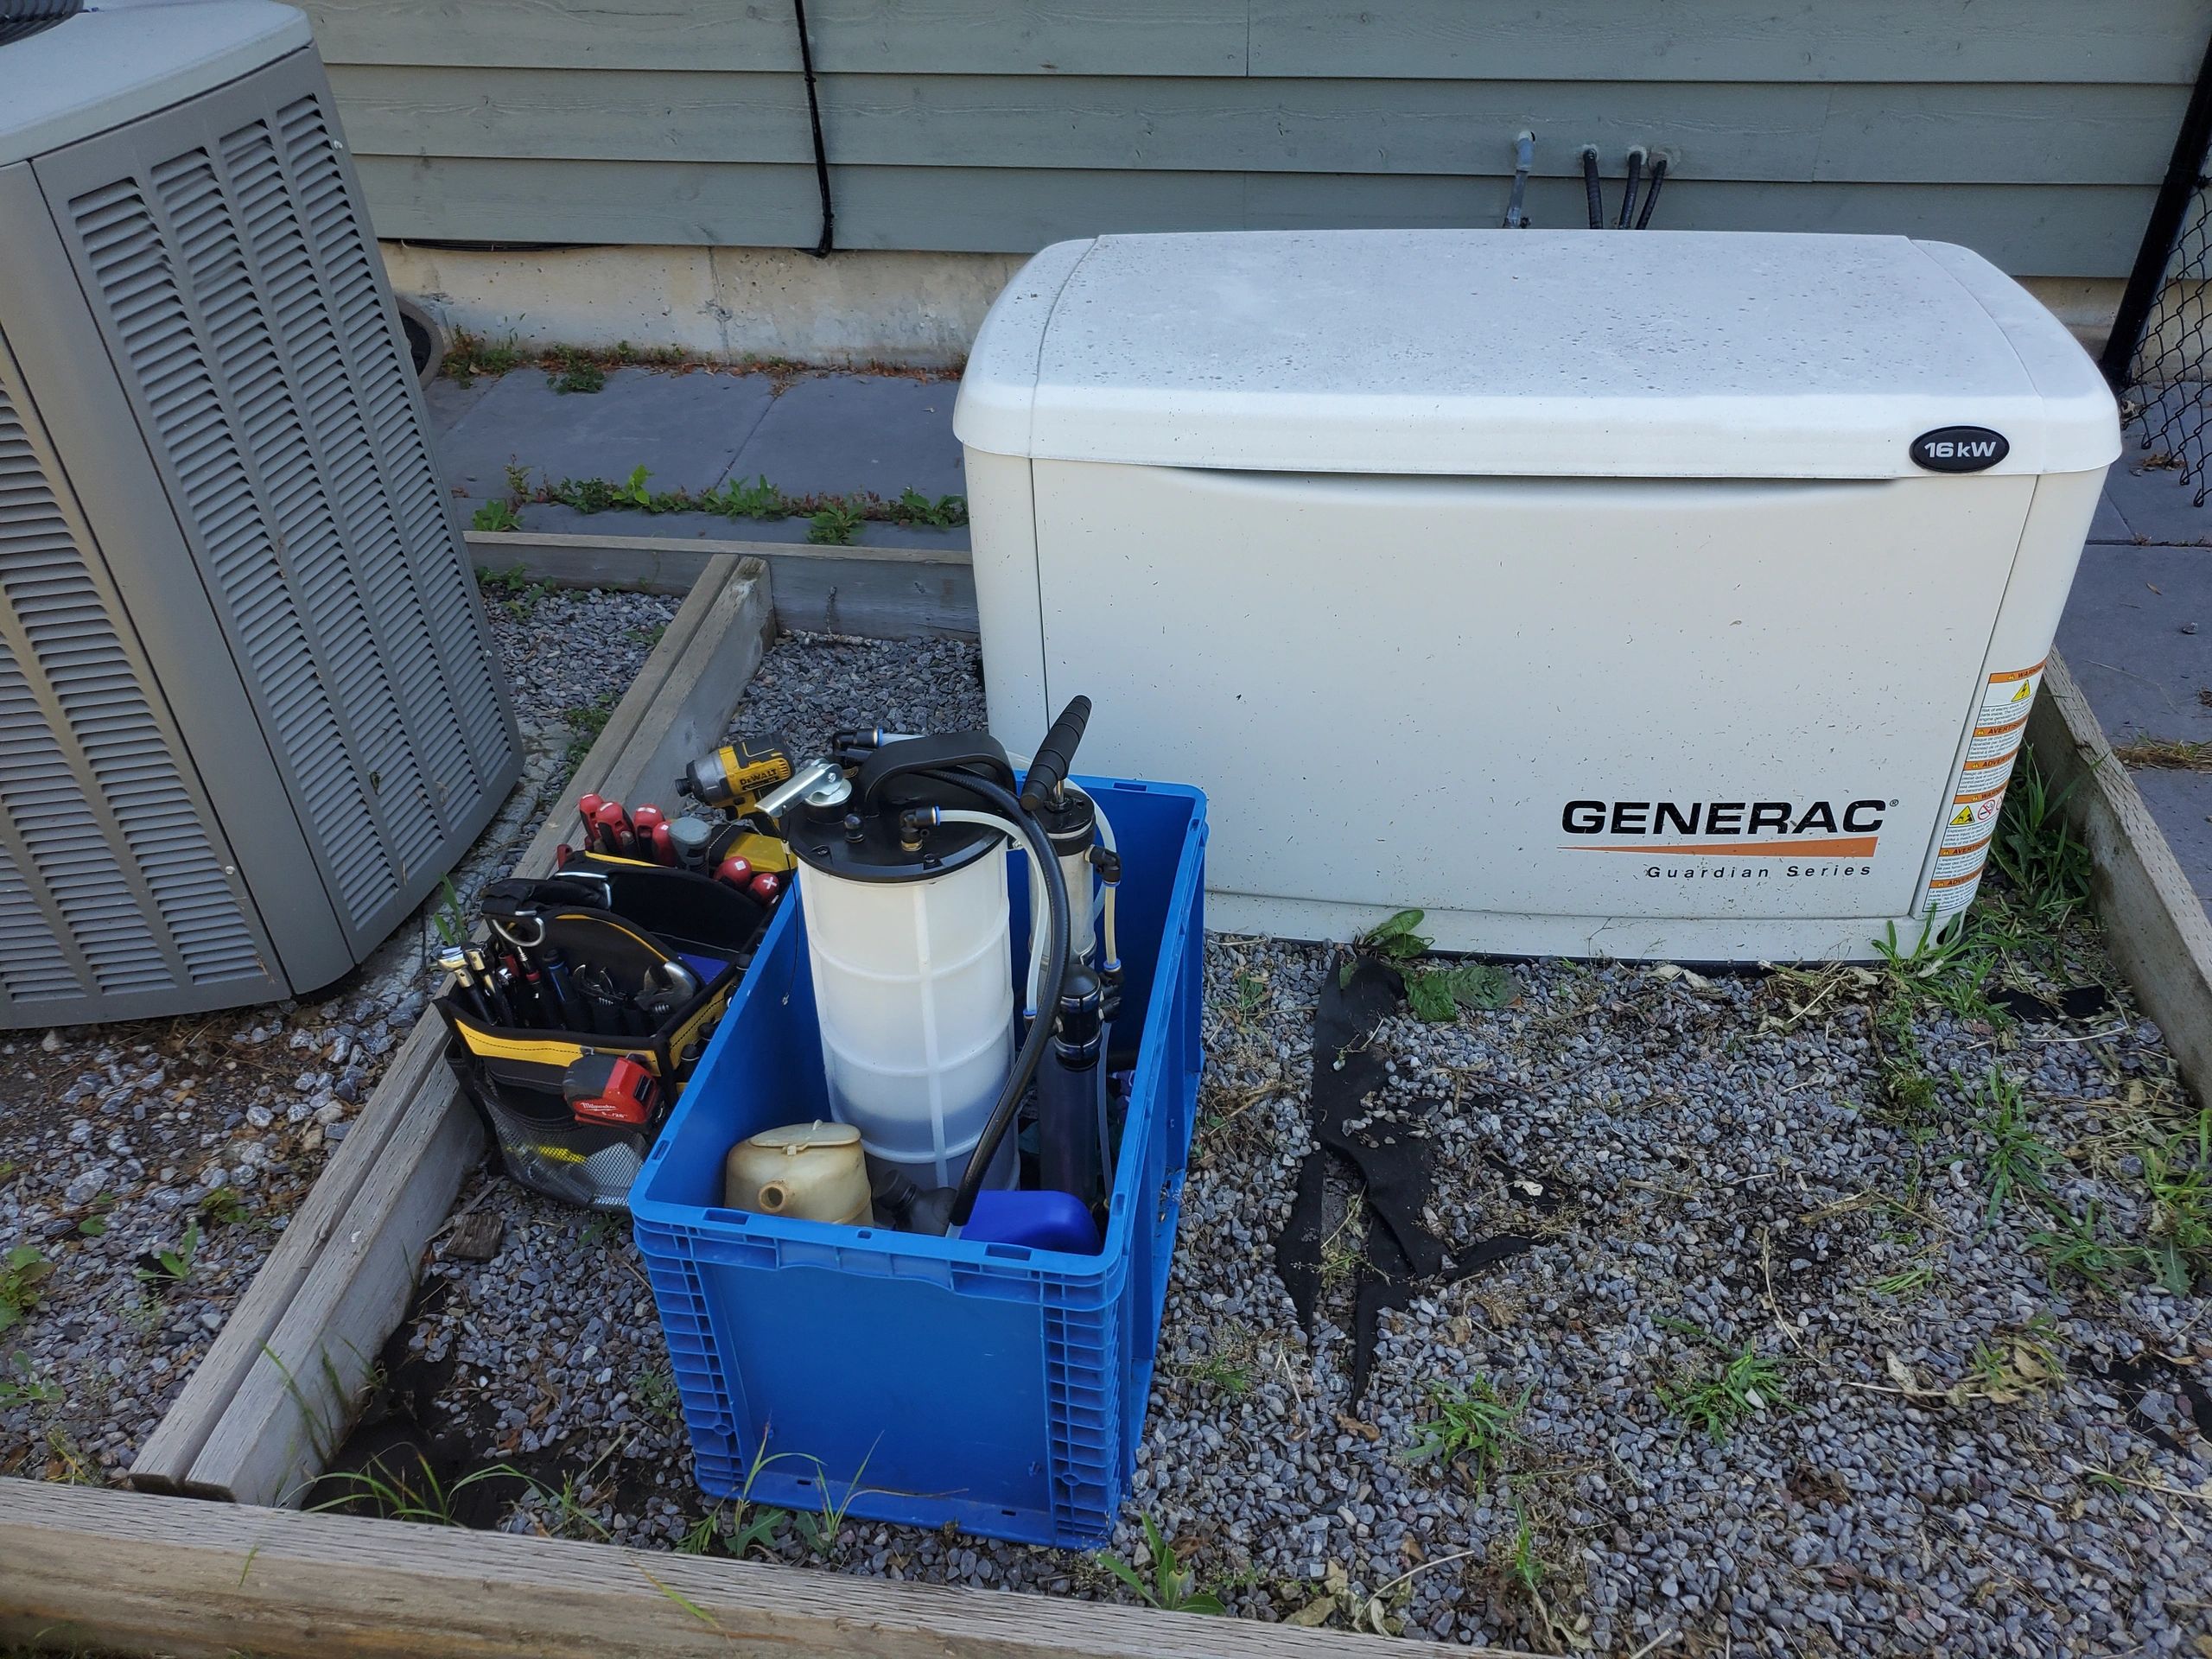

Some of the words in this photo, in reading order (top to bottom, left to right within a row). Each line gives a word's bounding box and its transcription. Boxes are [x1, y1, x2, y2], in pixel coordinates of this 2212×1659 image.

[1924, 442, 1955, 458] 16
[1957, 442, 1997, 458] kW
[1561, 799, 1886, 835] GENERAC
[1648, 866, 1770, 878] Guardian
[1787, 864, 1872, 877] Series
